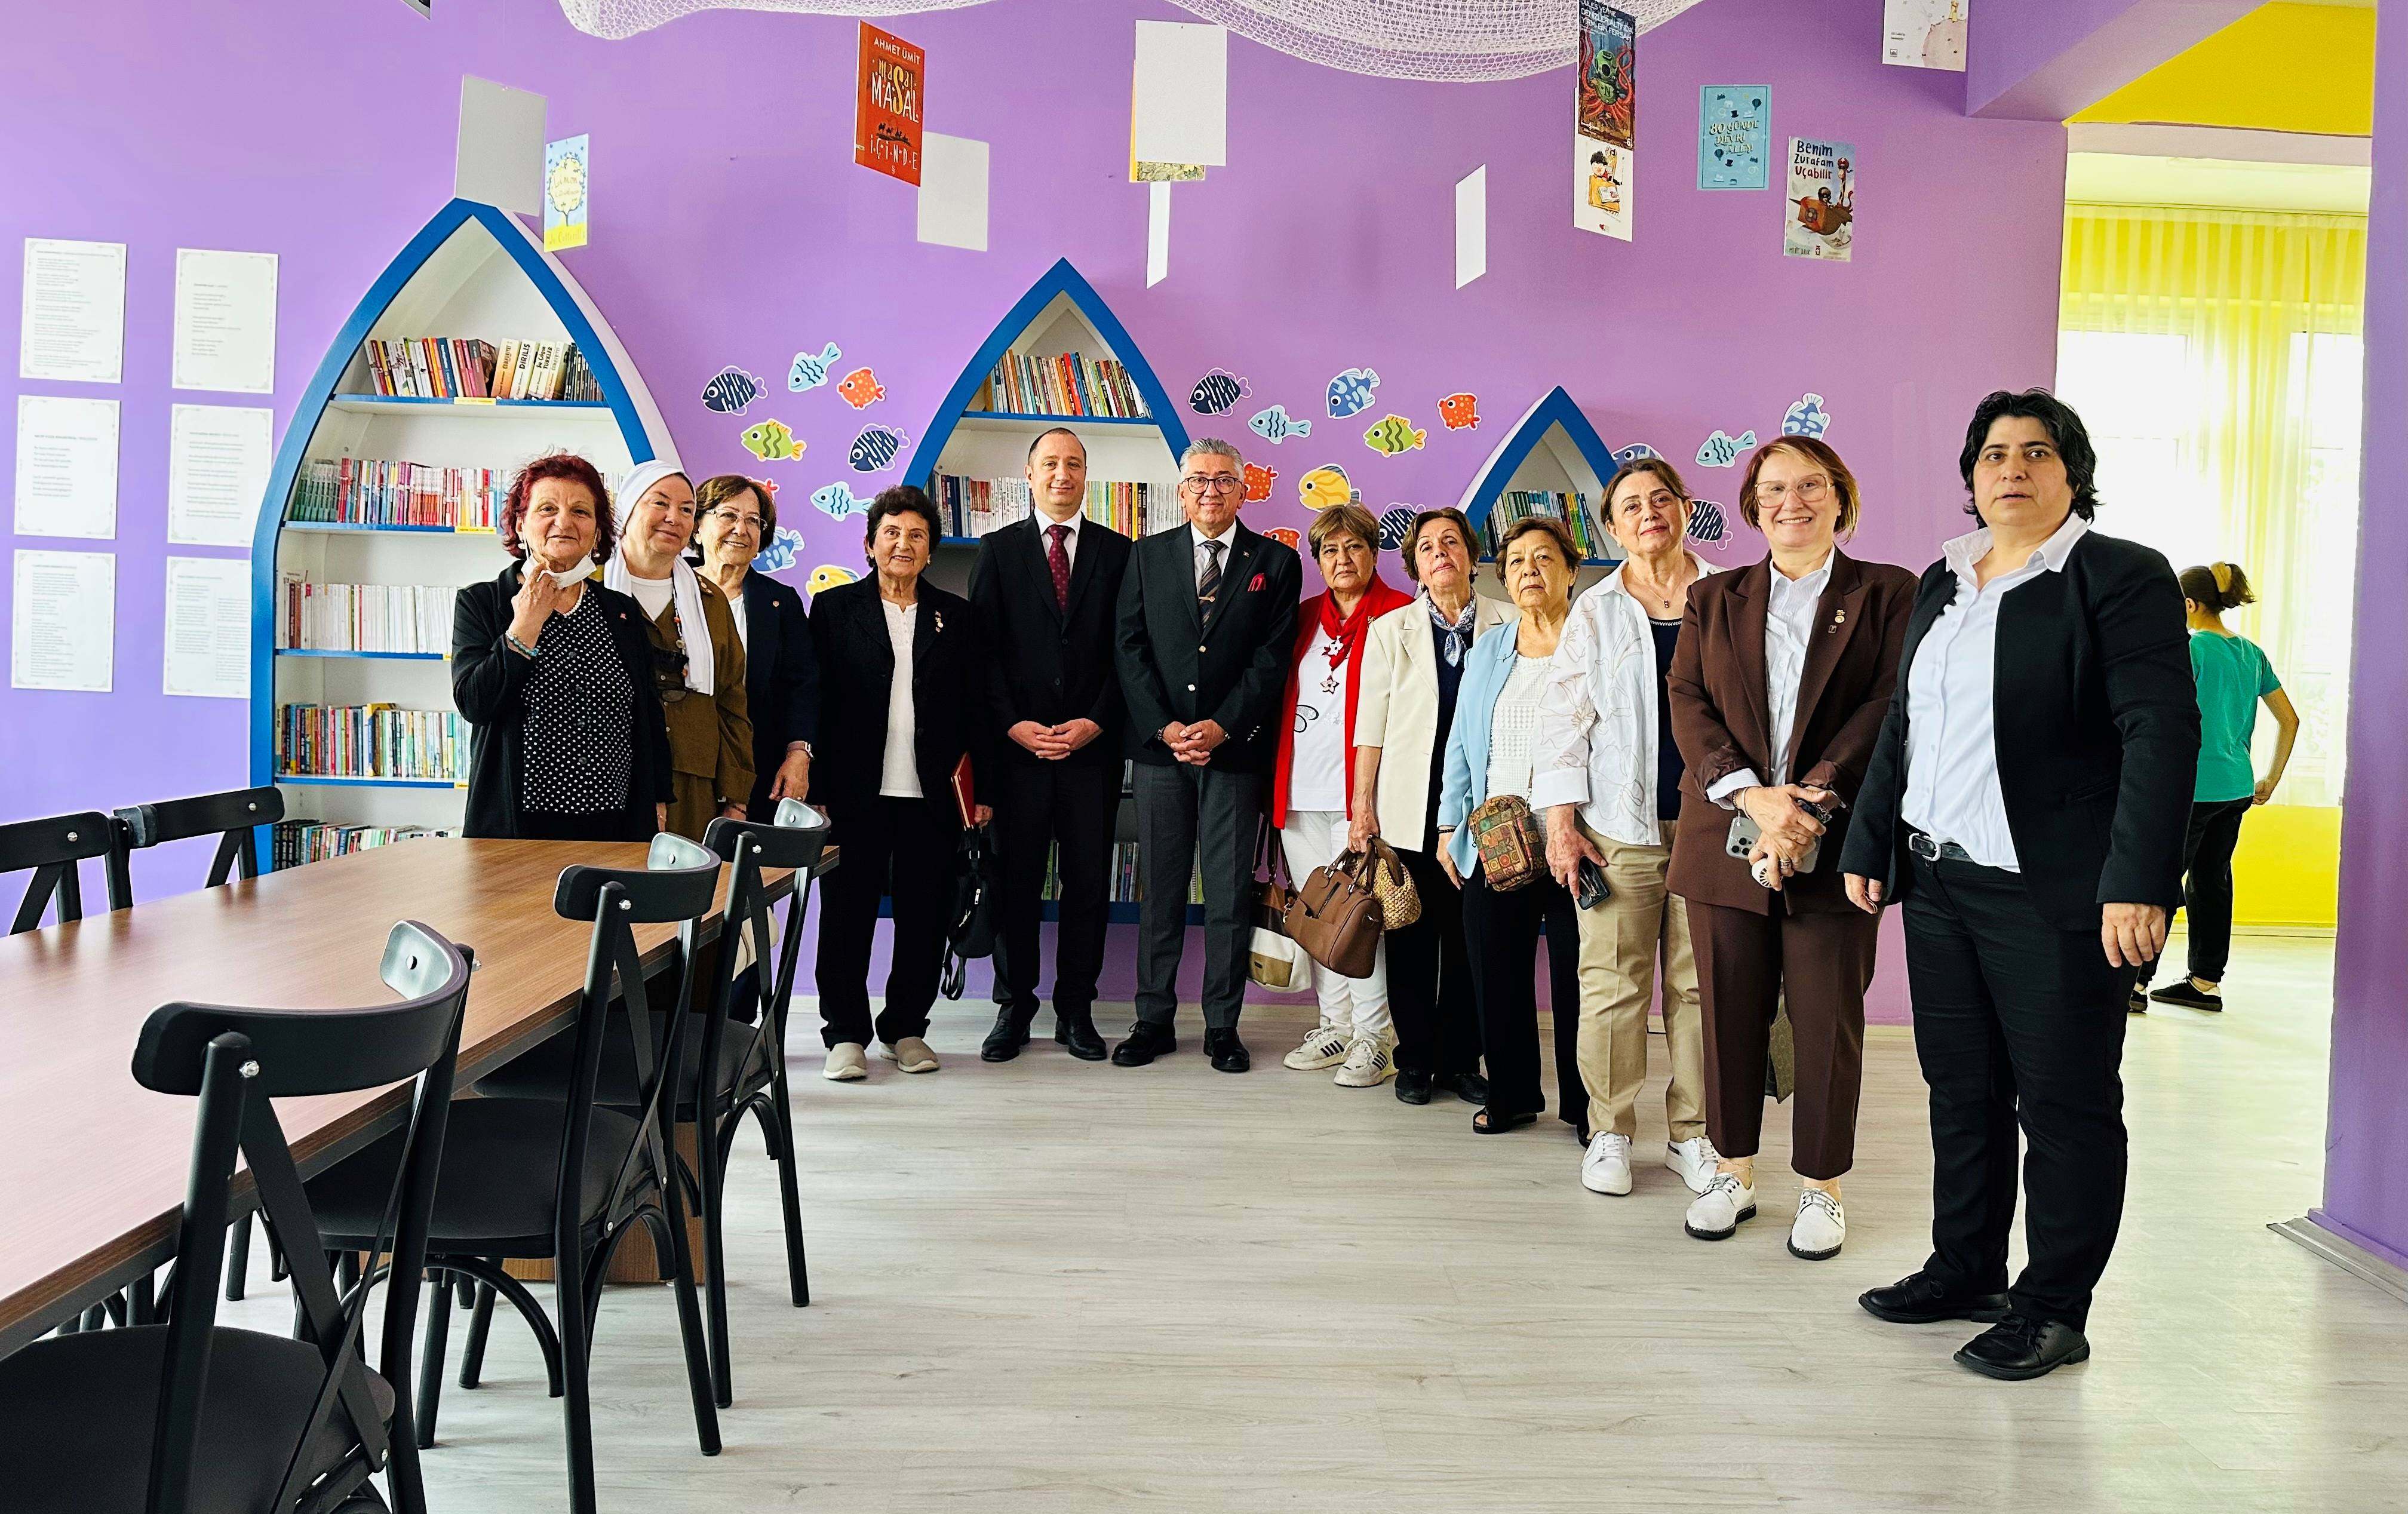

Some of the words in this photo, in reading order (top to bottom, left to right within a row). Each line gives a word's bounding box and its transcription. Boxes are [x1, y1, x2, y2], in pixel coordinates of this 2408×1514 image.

[874, 37, 901, 56] AHMET
[901, 47, 920, 65] ÜMİT
[1709, 123, 1725, 135] 80
[1796, 140, 1833, 156] Benim
